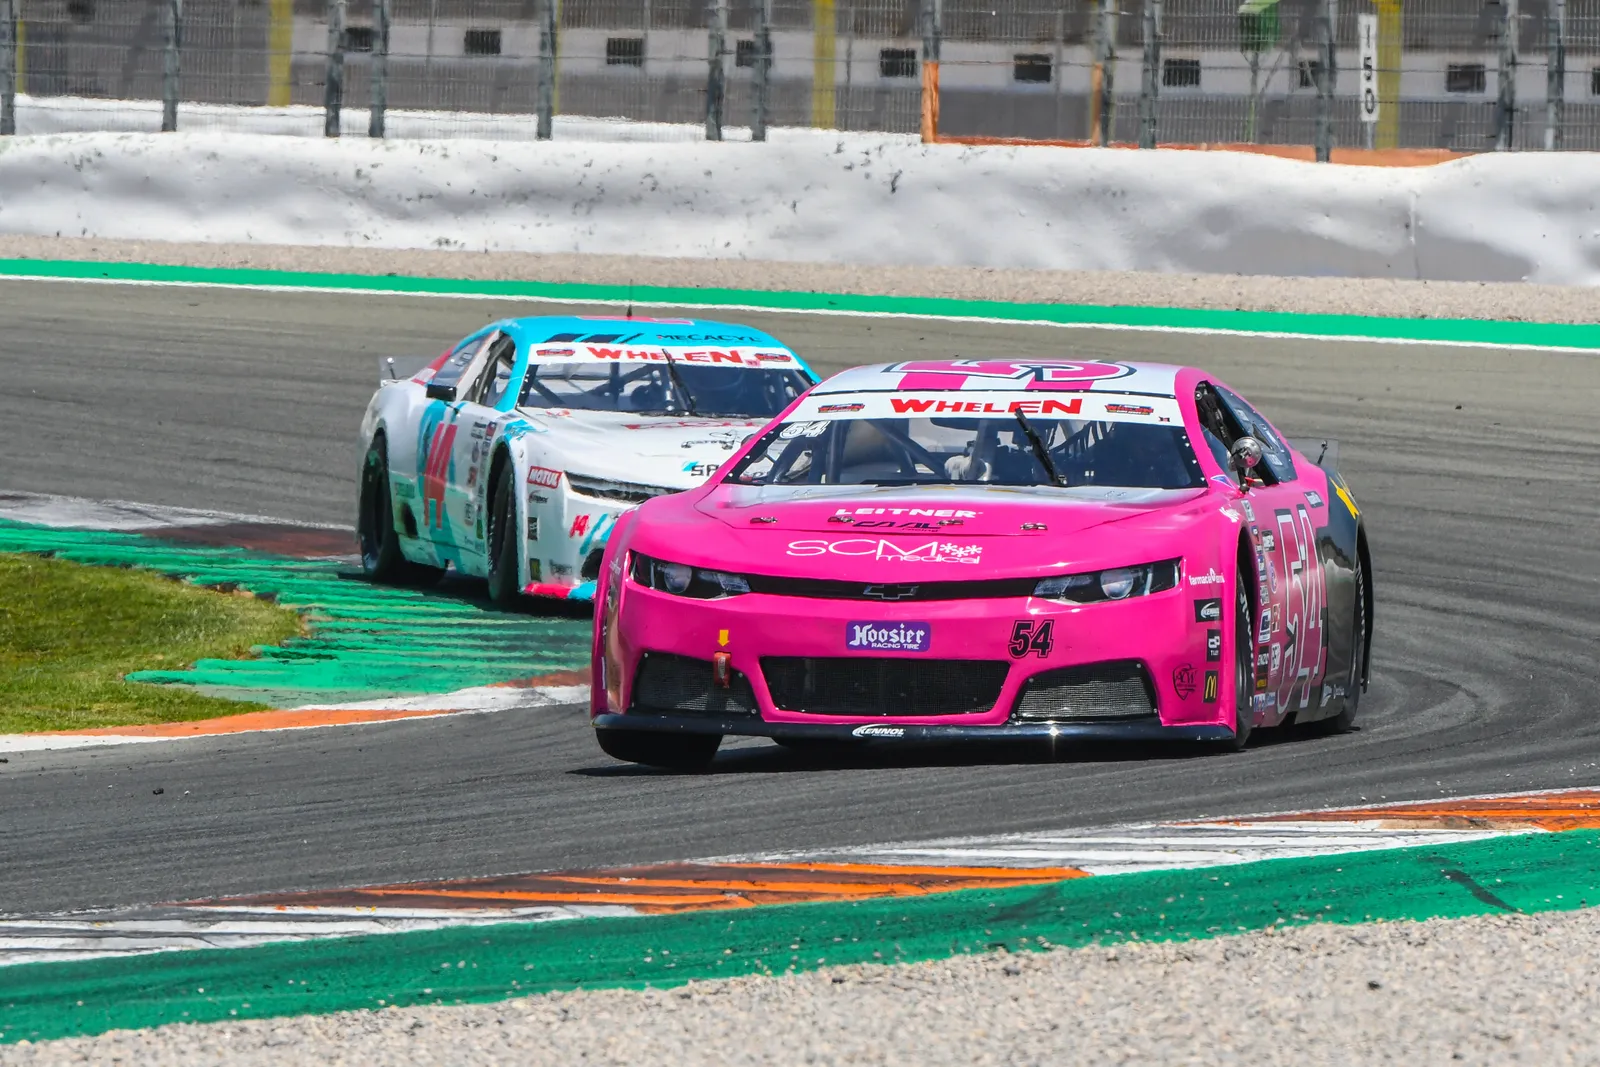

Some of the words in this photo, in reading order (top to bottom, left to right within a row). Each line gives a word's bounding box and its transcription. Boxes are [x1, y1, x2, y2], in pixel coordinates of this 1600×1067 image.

[1363, 24, 1375, 115] 150
[586, 346, 745, 365] WHELEN
[890, 398, 1082, 415] WHELEN
[779, 420, 831, 439] 54
[530, 468, 560, 487] MOTUL
[835, 508, 978, 518] LEITNER
[569, 514, 590, 538] 14
[786, 538, 938, 557] SCM
[876, 553, 981, 565] medical
[1275, 504, 1325, 710] 54
[849, 623, 925, 646] Hoosier
[1007, 619, 1055, 660] 54
[856, 727, 905, 736] KENNOL
